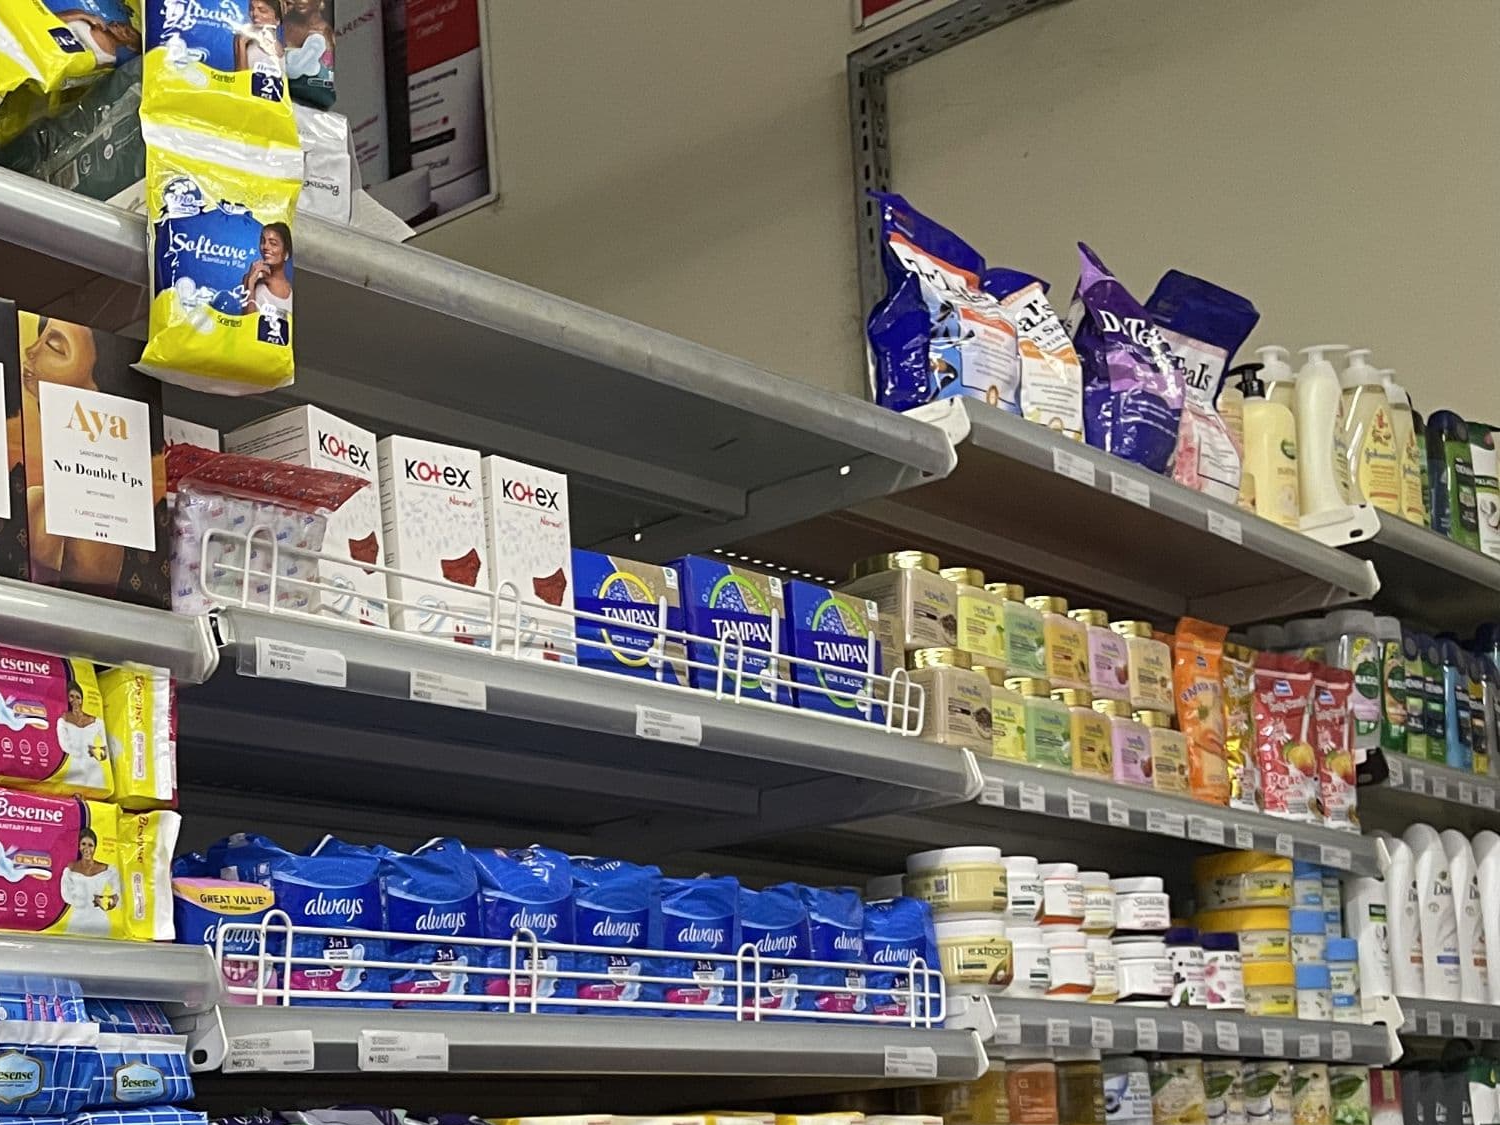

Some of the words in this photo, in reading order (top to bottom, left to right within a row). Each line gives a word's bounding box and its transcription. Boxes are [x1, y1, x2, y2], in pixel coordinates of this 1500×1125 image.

[173, 233, 248, 260] Softcare
[67, 401, 129, 443] Aya
[602, 608, 657, 627] TAMPAX
[712, 620, 772, 643] TAMPAX
[814, 641, 869, 664] TAMPAX
[200, 894, 232, 904] GREAT
[304, 892, 363, 921] always
[416, 908, 466, 934] always
[510, 908, 558, 934] always
[592, 916, 641, 946] always
[678, 922, 724, 949] always
